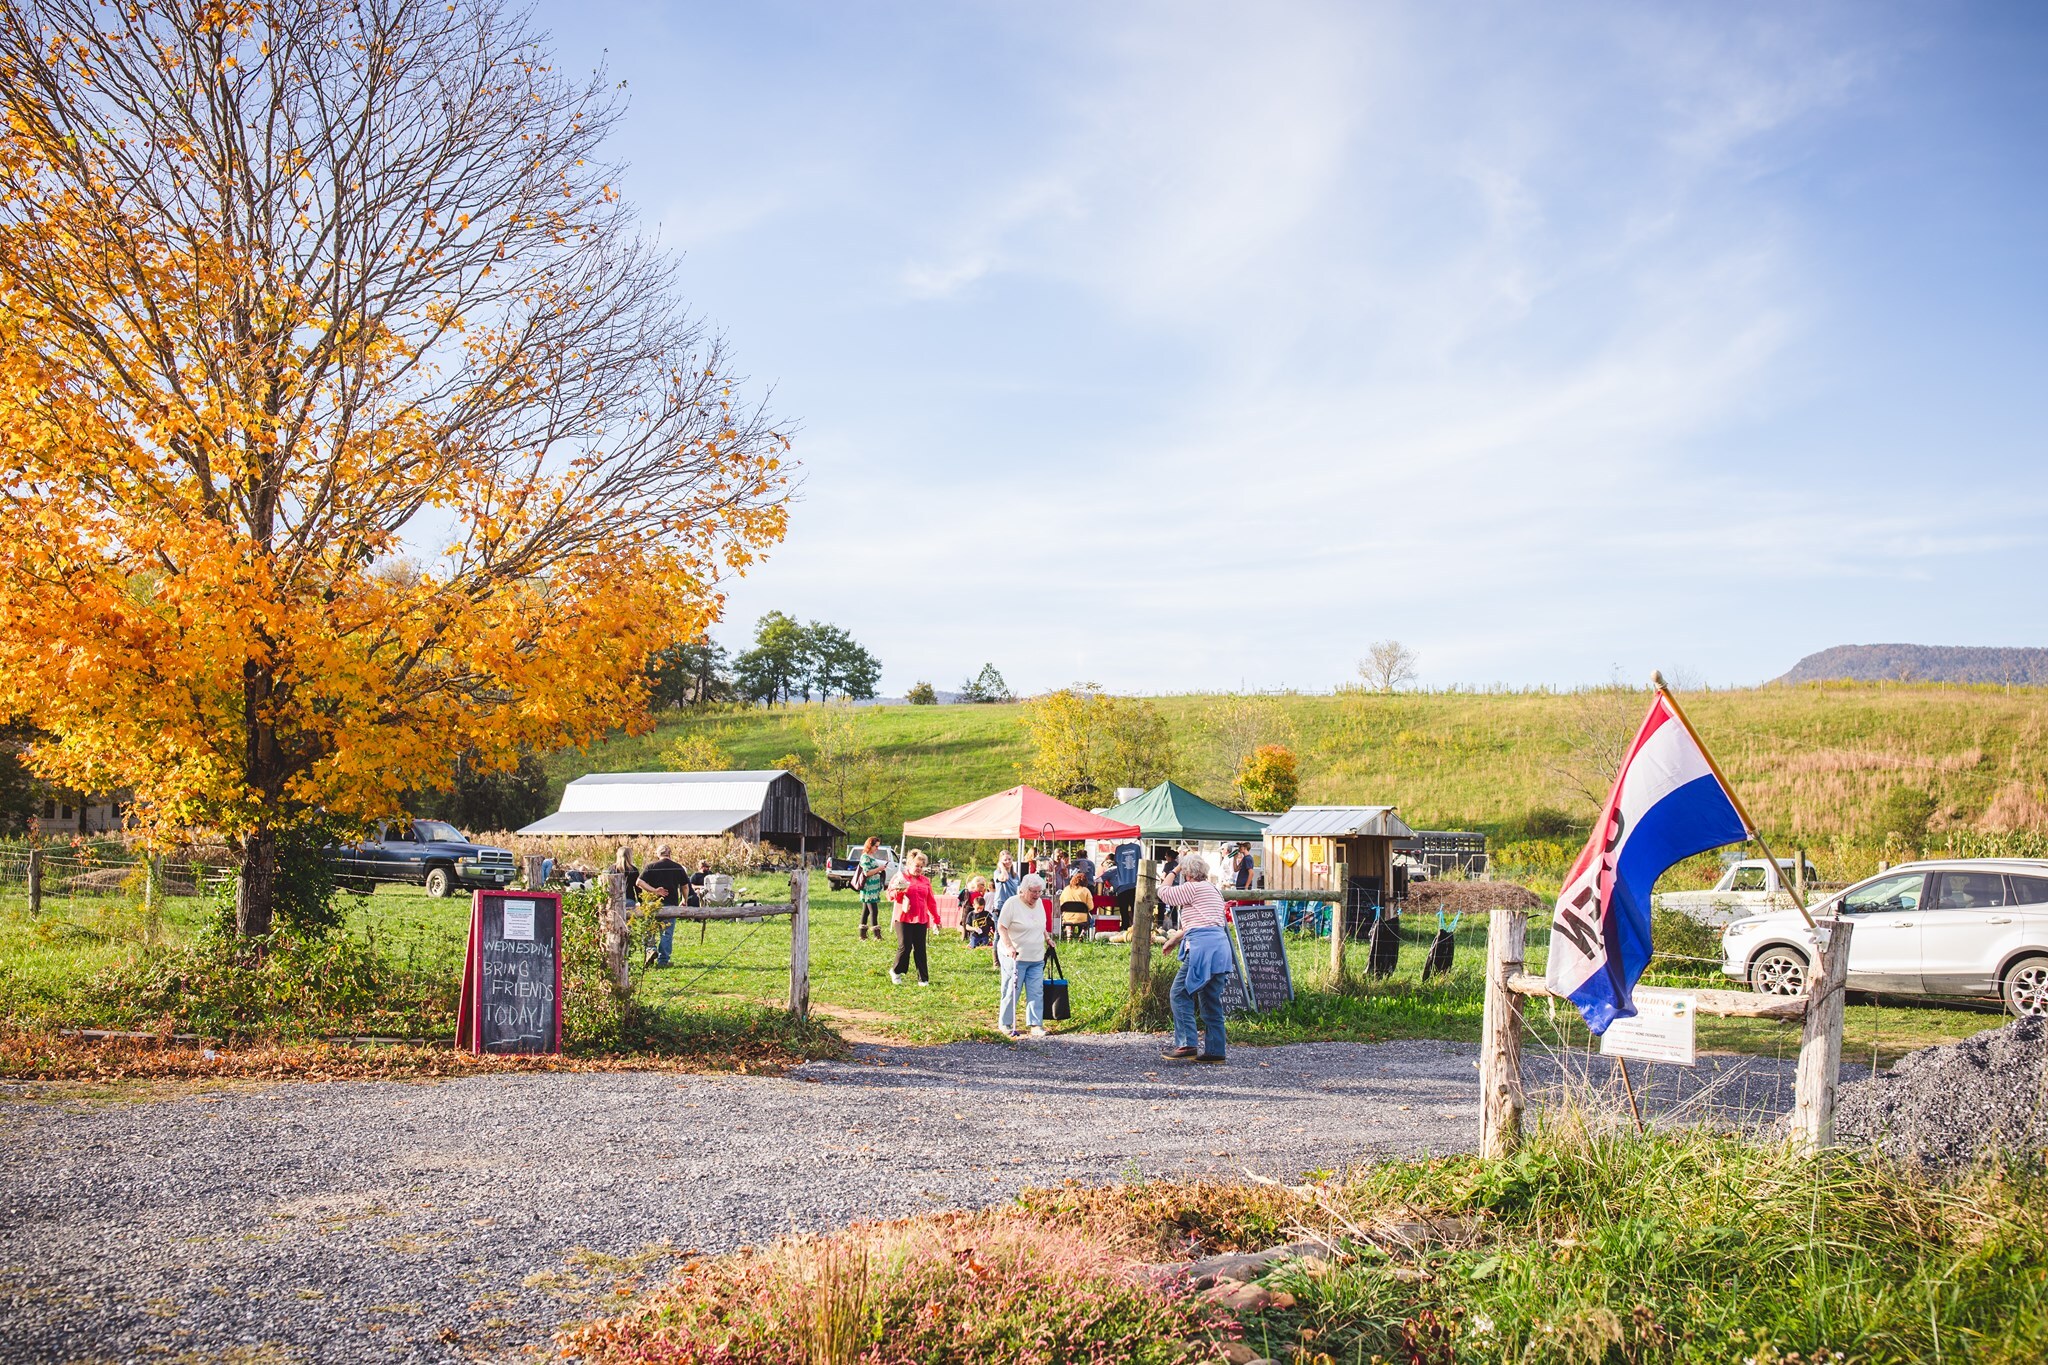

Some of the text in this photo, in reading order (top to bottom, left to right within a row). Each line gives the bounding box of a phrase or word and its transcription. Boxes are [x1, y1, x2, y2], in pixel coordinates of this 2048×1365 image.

[483, 936, 554, 958] WEDNESDAY!
[483, 960, 529, 977] BRING
[492, 979, 554, 1002] FRIENDS
[1632, 996, 1672, 1007] UILDING
[483, 1003, 544, 1033] TODAY!
